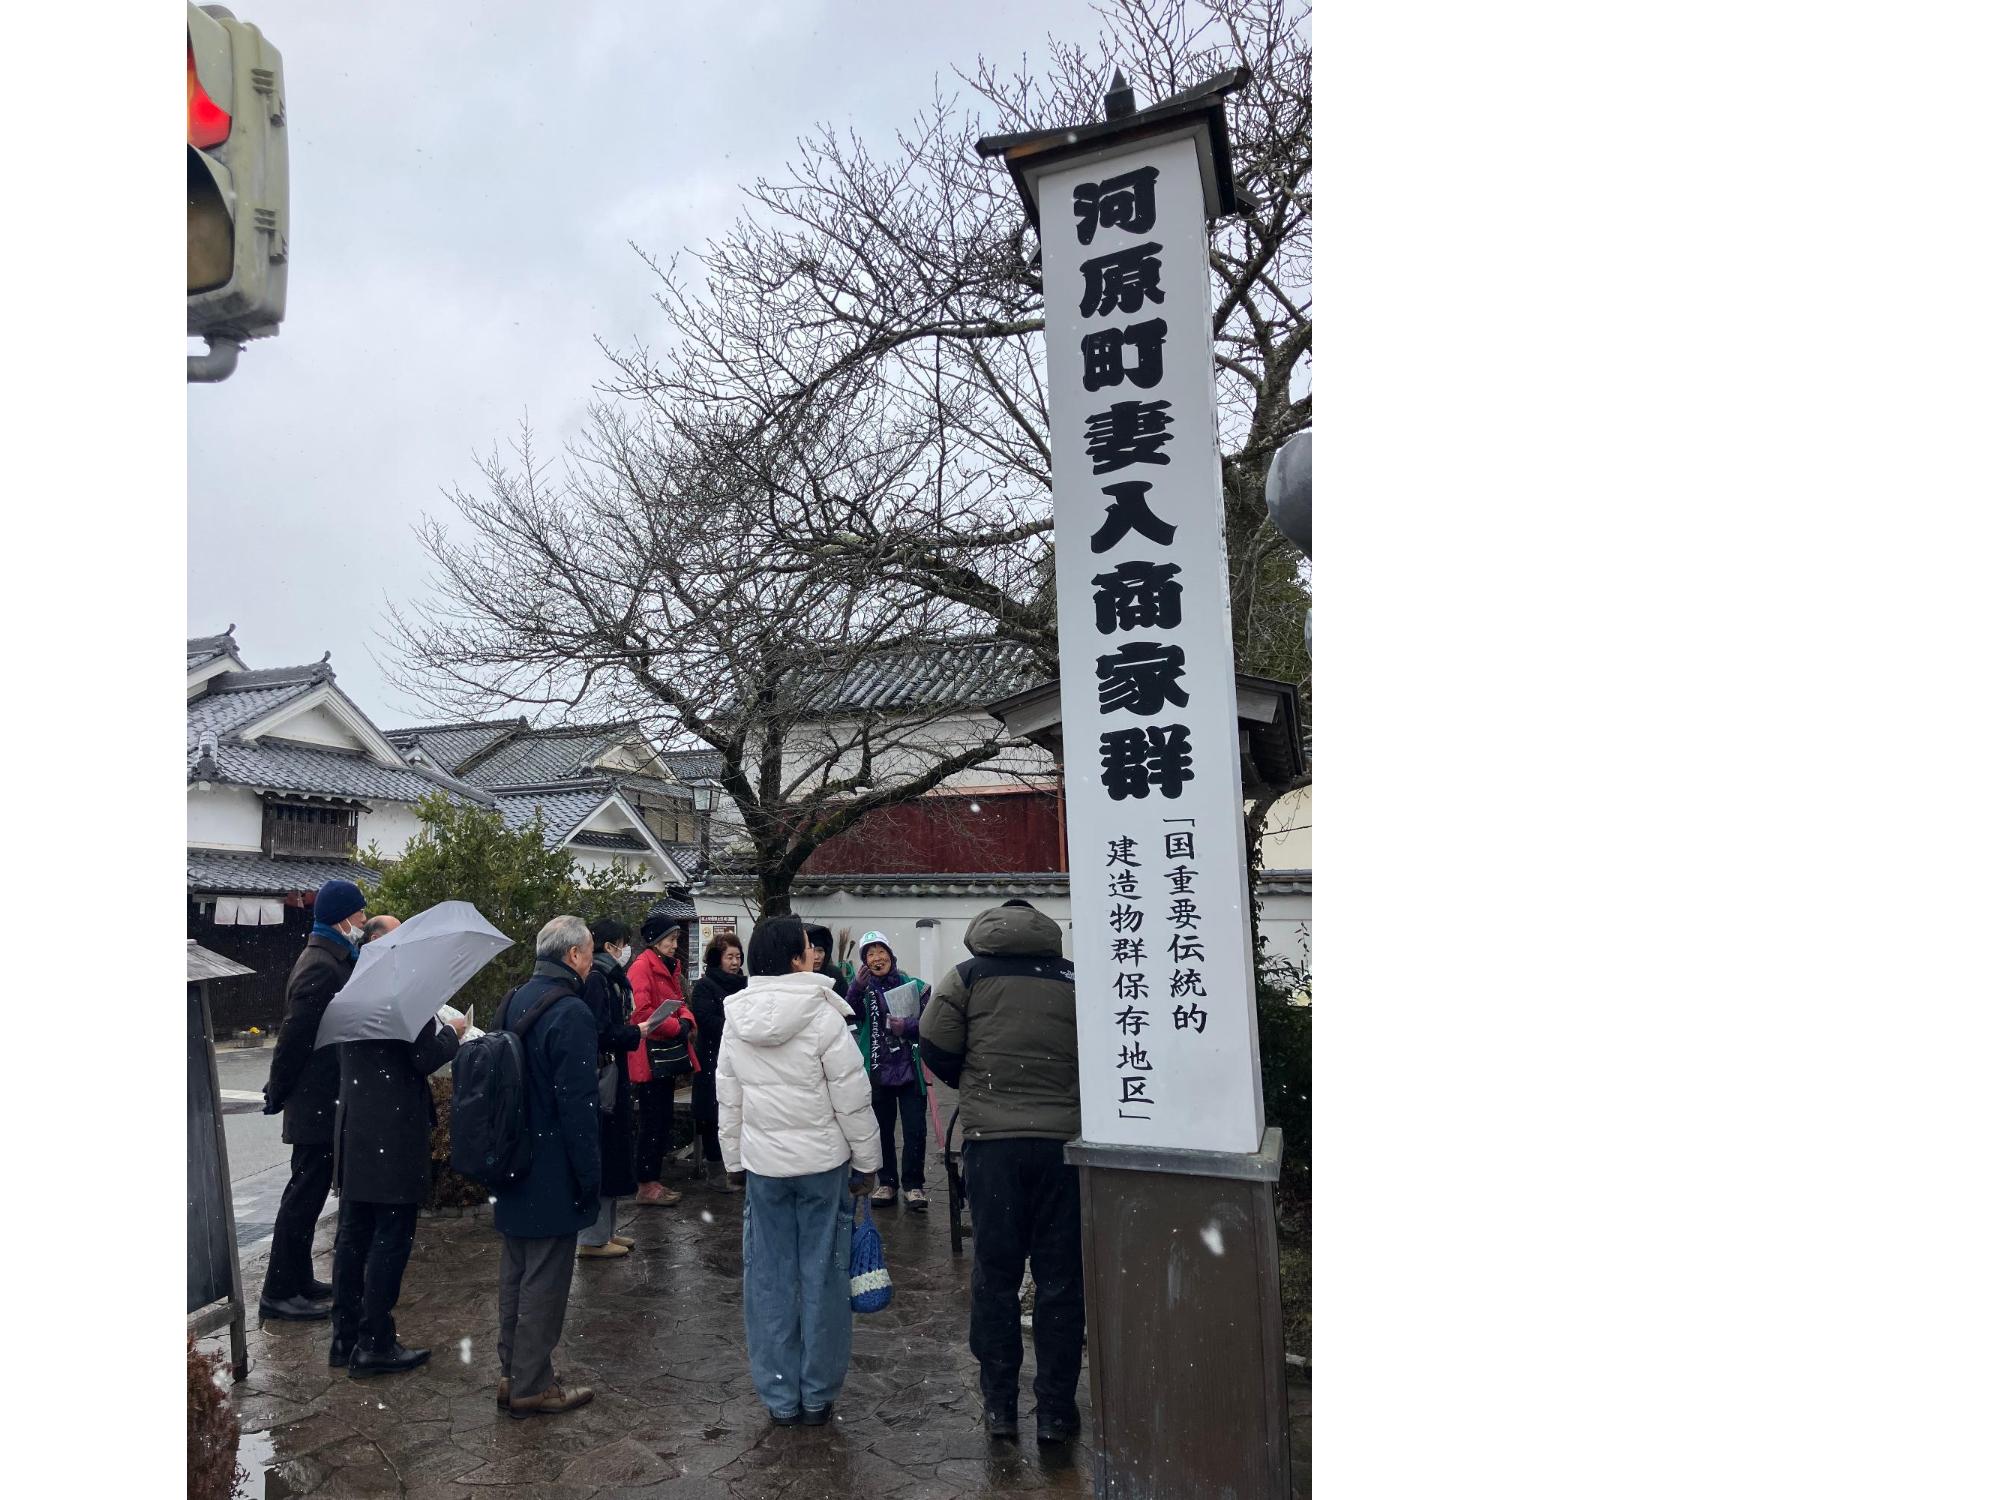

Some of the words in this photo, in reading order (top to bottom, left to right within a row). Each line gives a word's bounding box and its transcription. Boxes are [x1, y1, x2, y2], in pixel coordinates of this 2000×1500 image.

[1073, 165, 1195, 801] 河原町妻入商家群
[1105, 834, 1155, 1121] 建造物群保存地区」
[1162, 818, 1208, 1034] 「国重要伝統的
